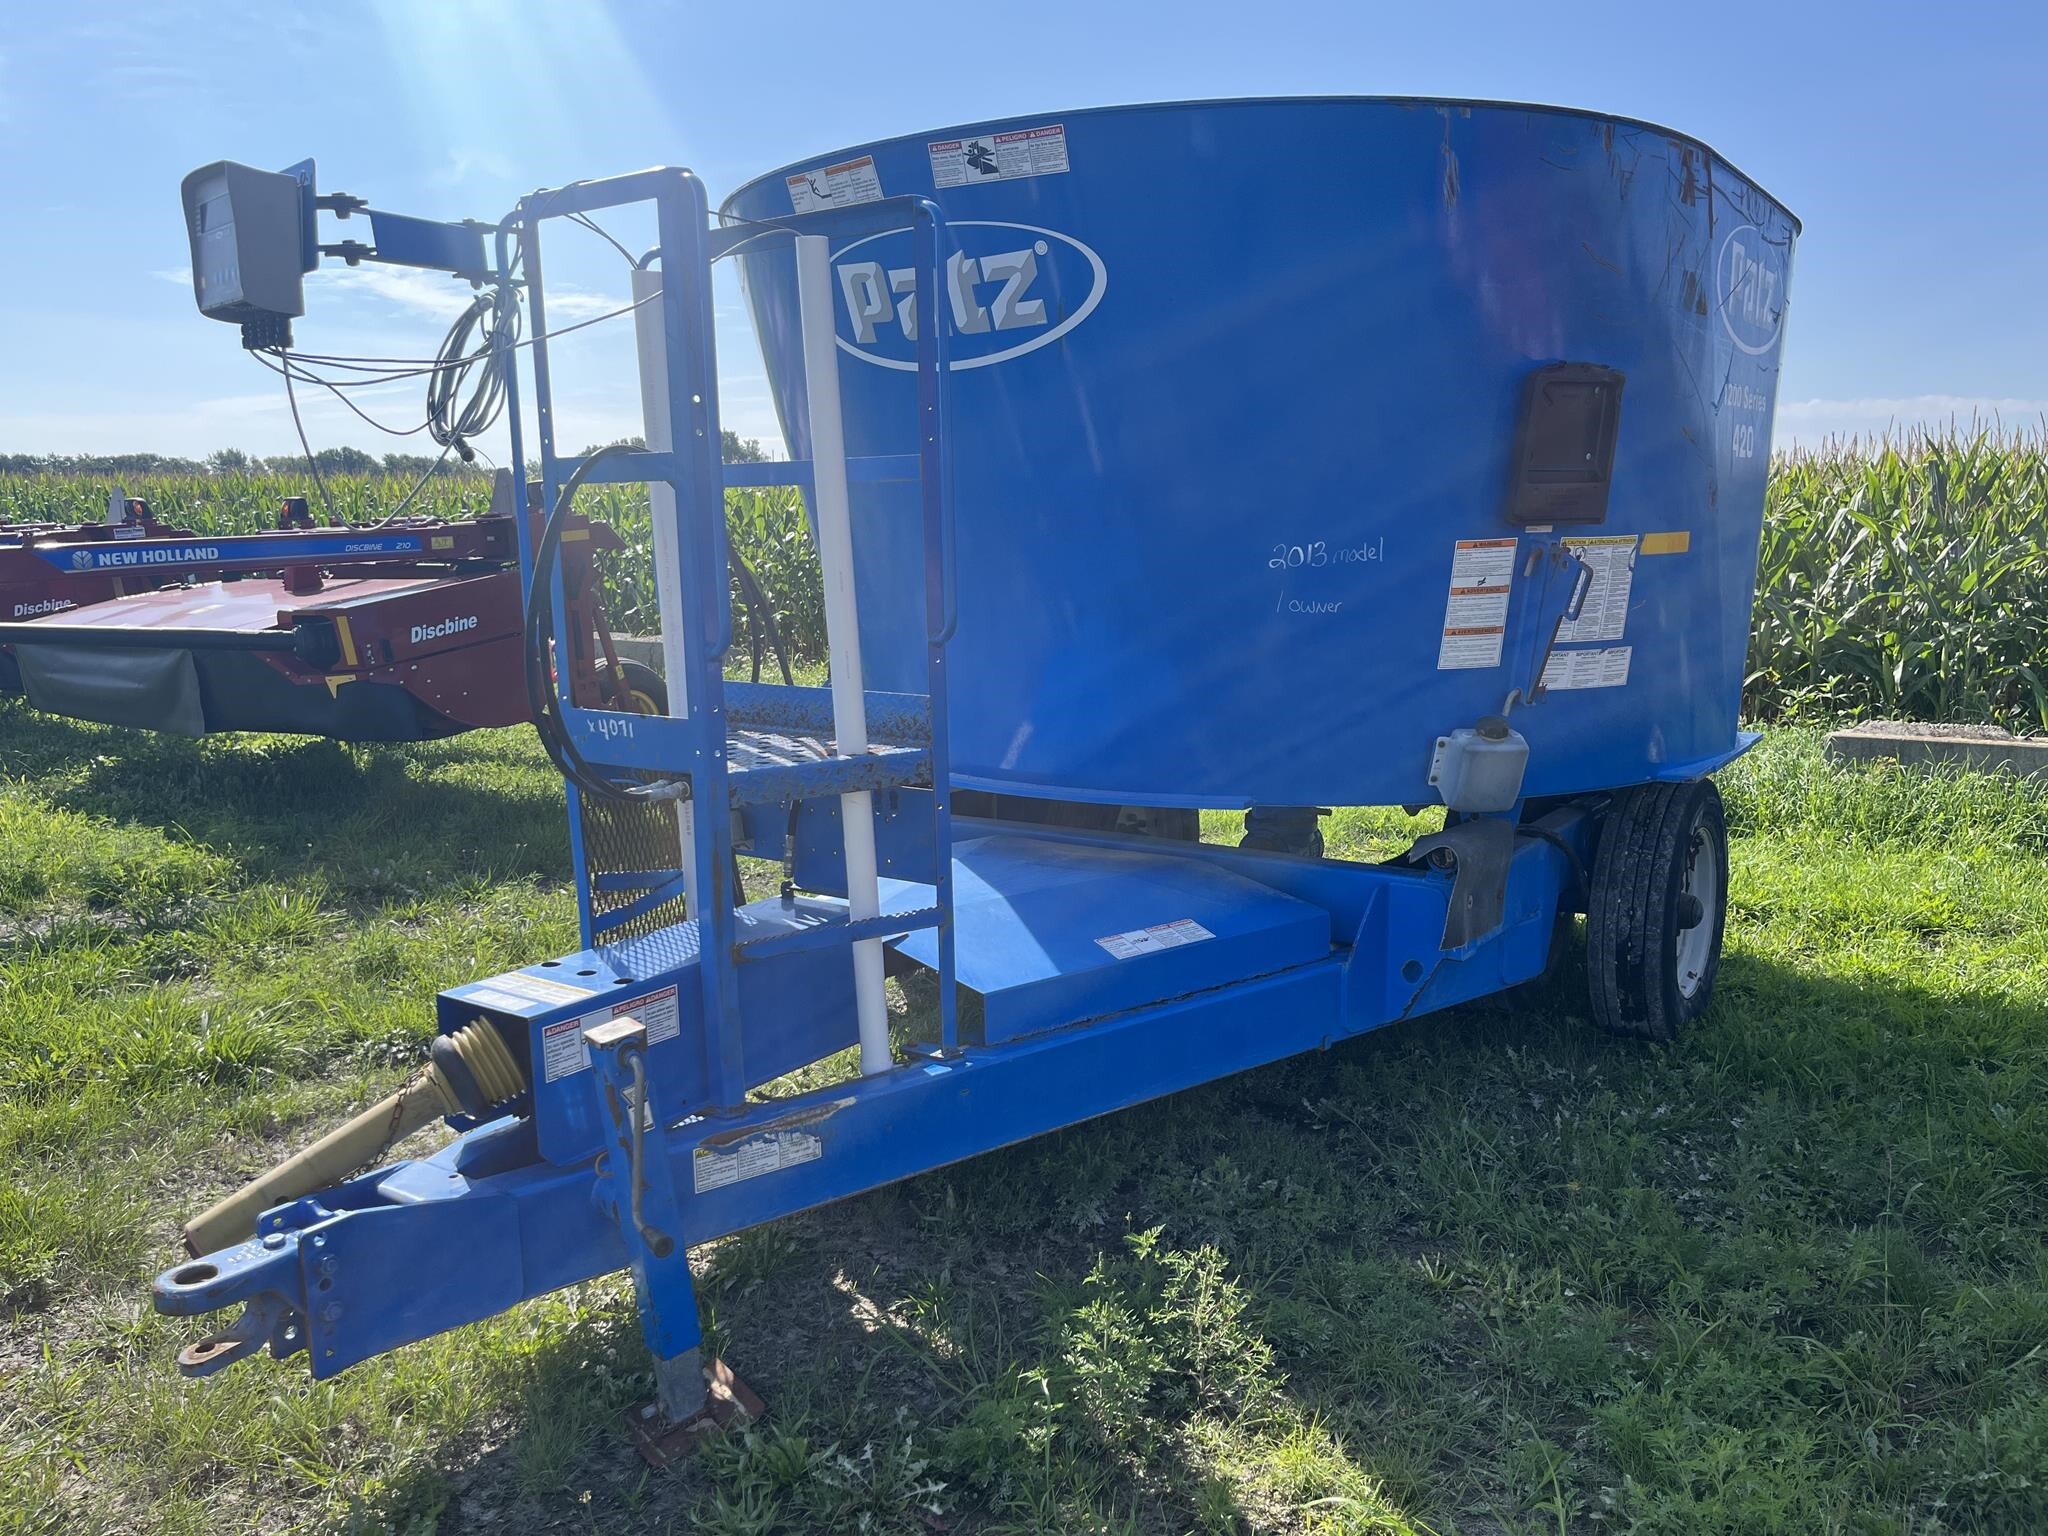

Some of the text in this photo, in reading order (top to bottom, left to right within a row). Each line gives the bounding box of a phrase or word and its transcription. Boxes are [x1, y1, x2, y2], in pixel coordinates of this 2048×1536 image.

[1729, 241, 1777, 331] Patz
[1744, 387, 1768, 412] Series
[1732, 424, 1754, 459] 420
[98, 547, 219, 566] NEW HOLLAND
[345, 542, 411, 552] DISCBINE 210
[1268, 536, 1384, 569] 2013 model
[14, 598, 71, 617] Discbine
[411, 615, 478, 643] Discbine
[650, 987, 676, 1001] DANGER
[618, 999, 645, 1012] PELIGRO
[551, 1020, 579, 1034] DANGER
